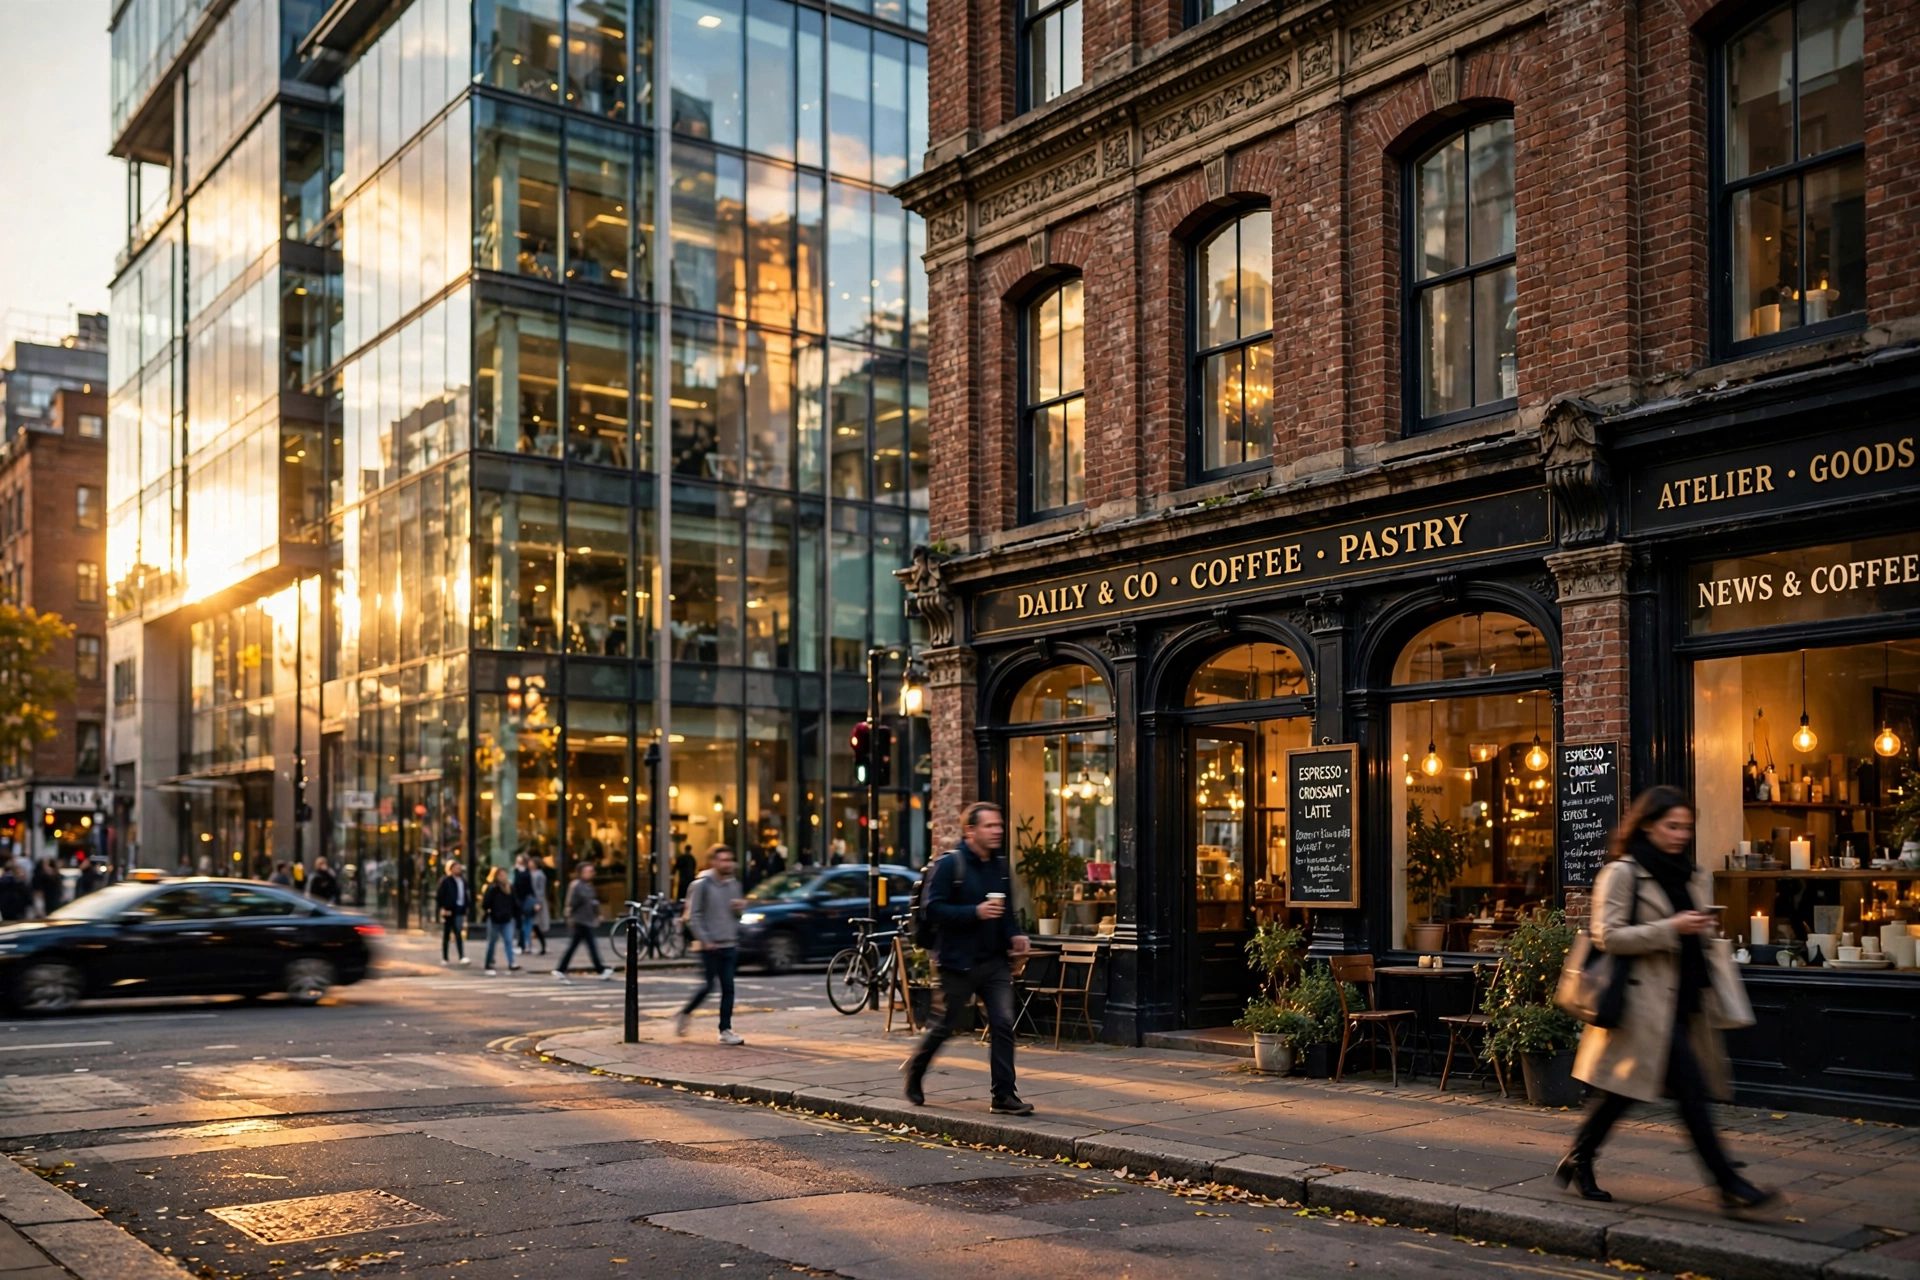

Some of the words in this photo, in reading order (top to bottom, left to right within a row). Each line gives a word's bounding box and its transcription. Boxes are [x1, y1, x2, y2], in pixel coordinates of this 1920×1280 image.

[1657, 465, 1775, 510] ATELIER
[1809, 438, 1915, 483] GOODS
[1018, 583, 1088, 619] DAILY
[1097, 580, 1114, 605] &
[1123, 571, 1158, 600] CO
[1190, 544, 1302, 589] COFFEE
[1339, 513, 1469, 564] PASTRY
[1698, 574, 1773, 608] NEWS
[1782, 570, 1802, 598] &
[1810, 554, 1920, 594] COFFEE
[1299, 765, 1342, 781] ESPRESSO
[1299, 784, 1343, 800] CROISSANT
[1570, 780, 1597, 795] LATTE
[1304, 804, 1332, 819] LATTE
